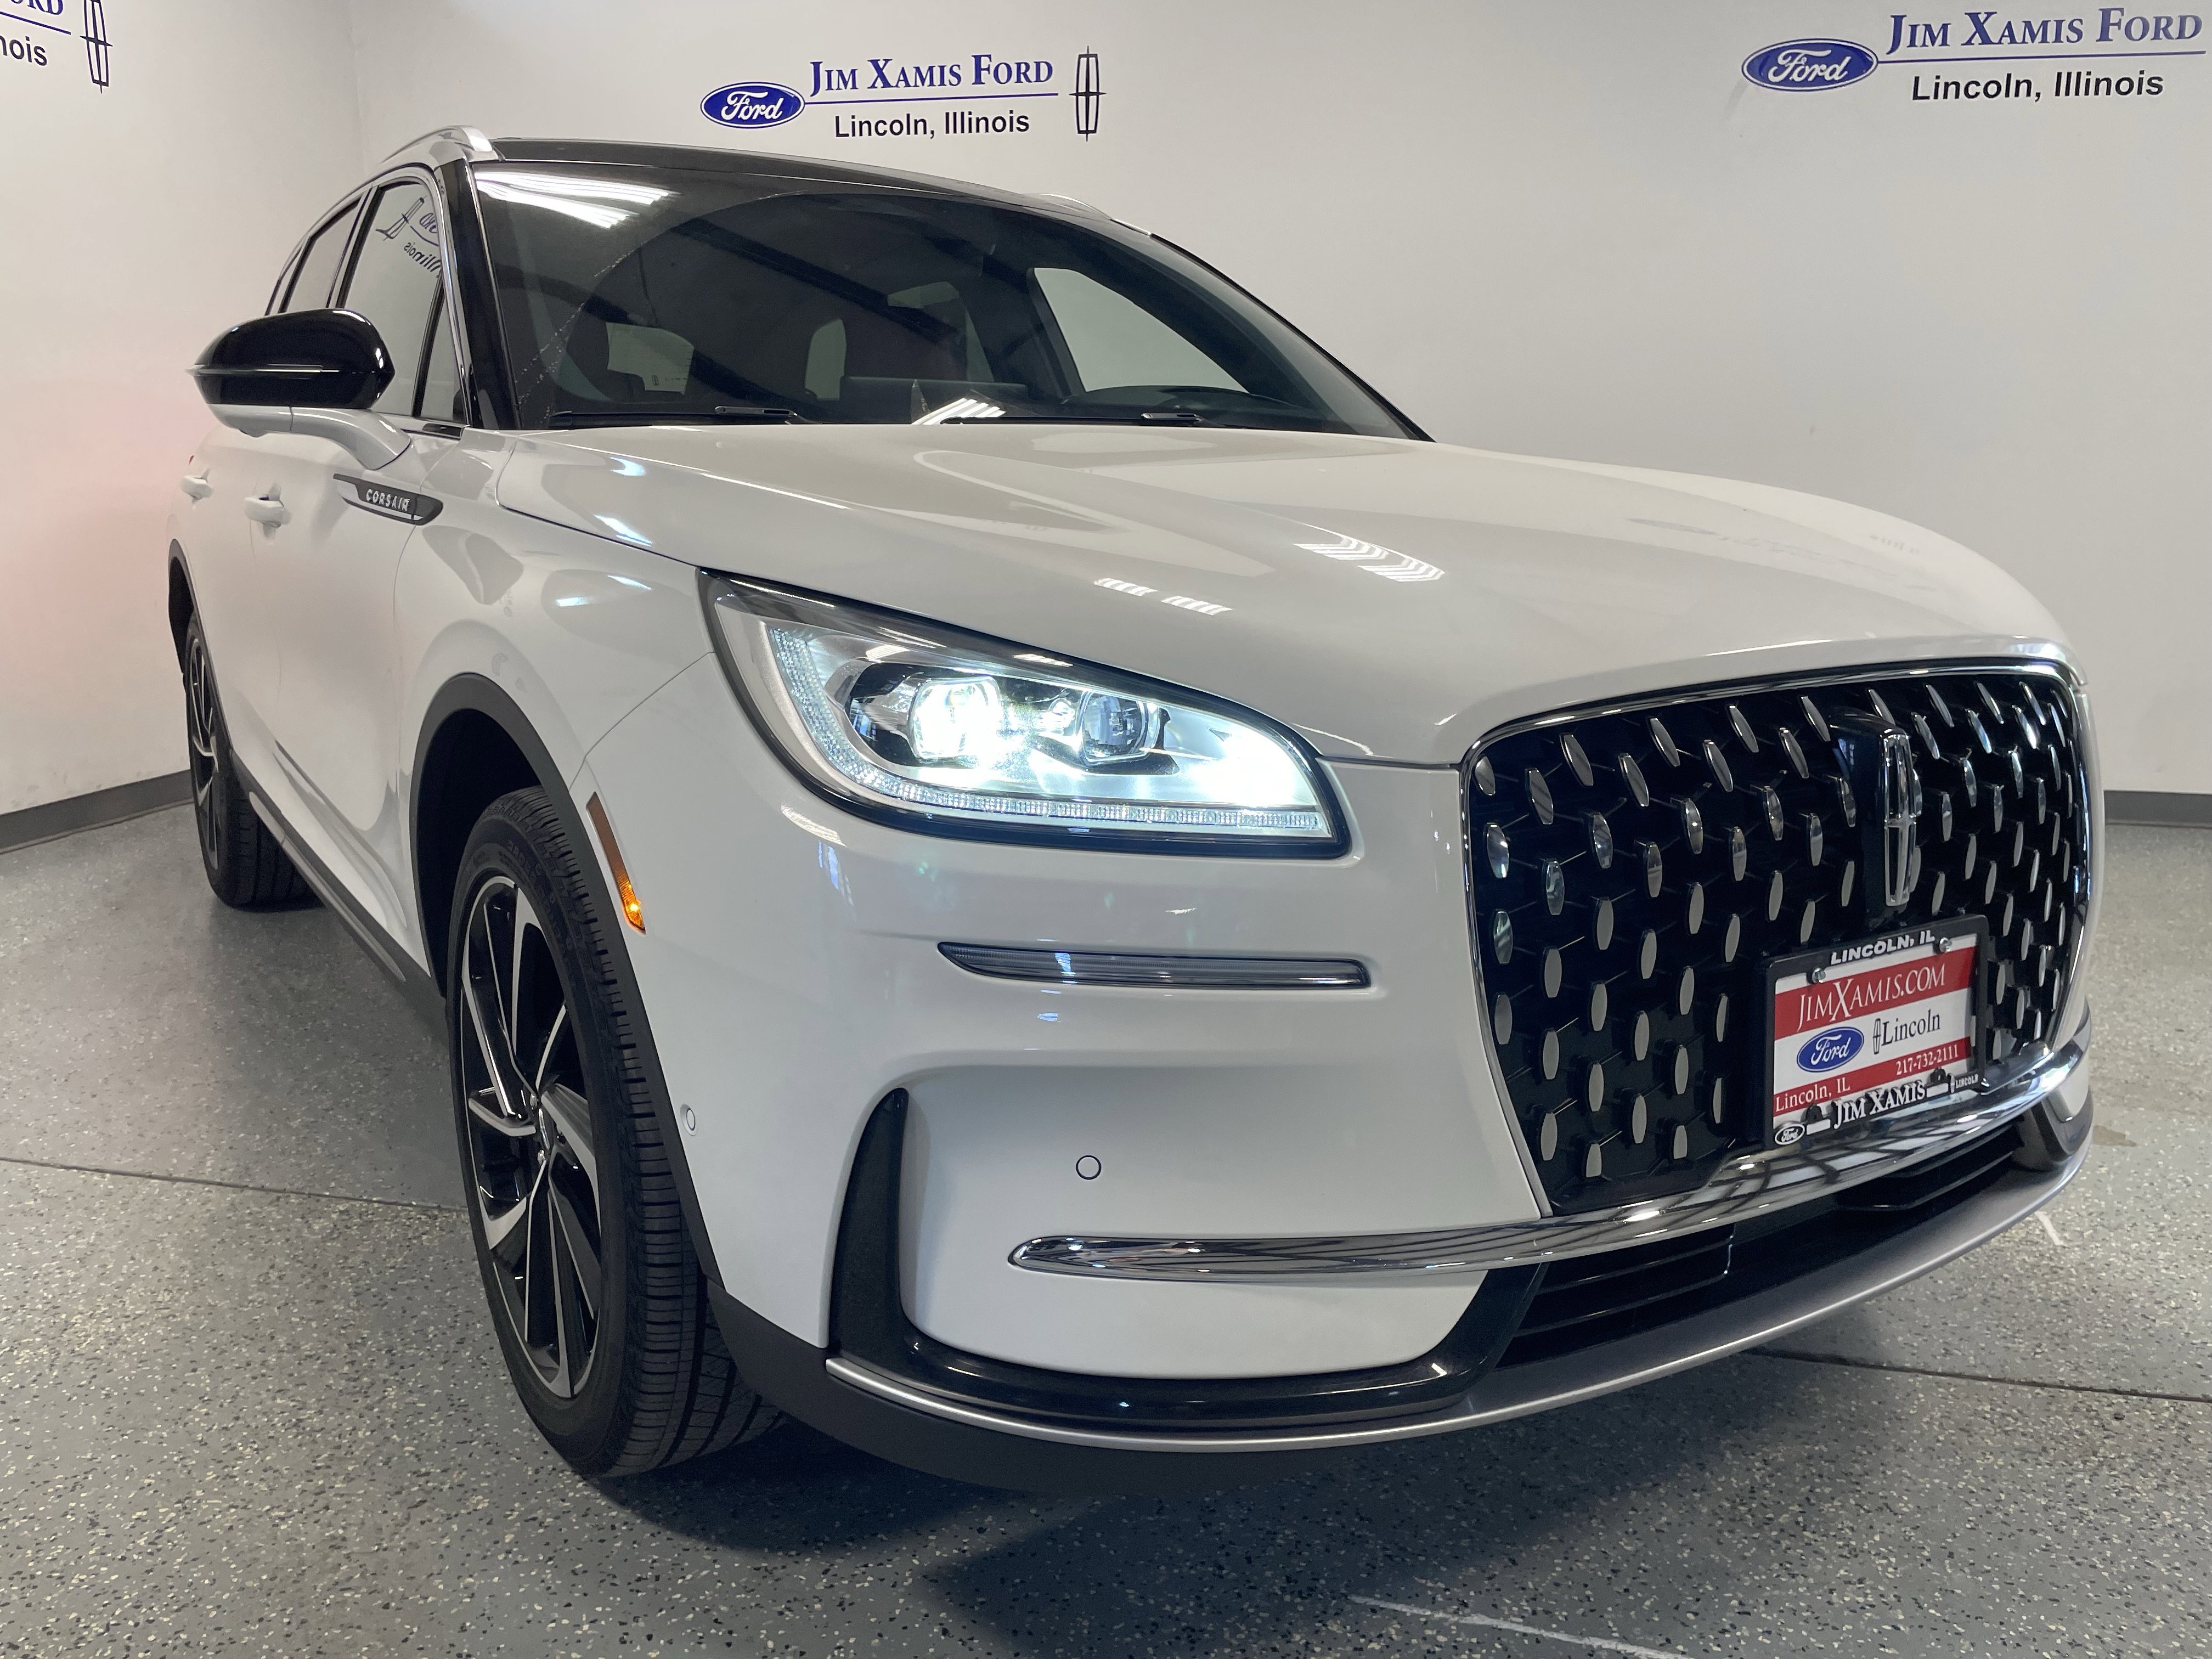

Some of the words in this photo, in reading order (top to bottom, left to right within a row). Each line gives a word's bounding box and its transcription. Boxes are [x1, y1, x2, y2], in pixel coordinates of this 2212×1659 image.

[1886, 14, 1951, 55] JIM
[1961, 11, 2084, 47] XAMIS
[2095, 8, 2203, 42] FORD
[810, 61, 859, 97] JIM
[867, 58, 962, 89] XAMIS
[971, 54, 1053, 85] FORD
[1768, 49, 1849, 82] Ford
[1912, 72, 2041, 102] Lincoln,
[2055, 70, 2164, 97] Illinois
[720, 91, 783, 121] Ford
[835, 113, 935, 139] Lincoln,
[945, 110, 1030, 134] Illinois
[365, 488, 410, 512] CORSAIR
[1830, 935, 1915, 965] LINCOLN,
[1920, 929, 1935, 945] IL
[1796, 963, 1945, 1032] JIMXAMIS.COM
[1881, 1008, 1941, 1046] Lincoln
[1810, 1034, 1852, 1065] Ford
[1895, 1044, 1959, 1076] 217-732-2111
[1775, 1084, 1832, 1113] Lincoln,
[1836, 1077, 1851, 1094] IL
[1955, 1074, 1979, 1089] LINCOLN
[1833, 1097, 1867, 1130] JIM
[1866, 1079, 1926, 1116] XAMIS
[1781, 1128, 1799, 1142] Ford
